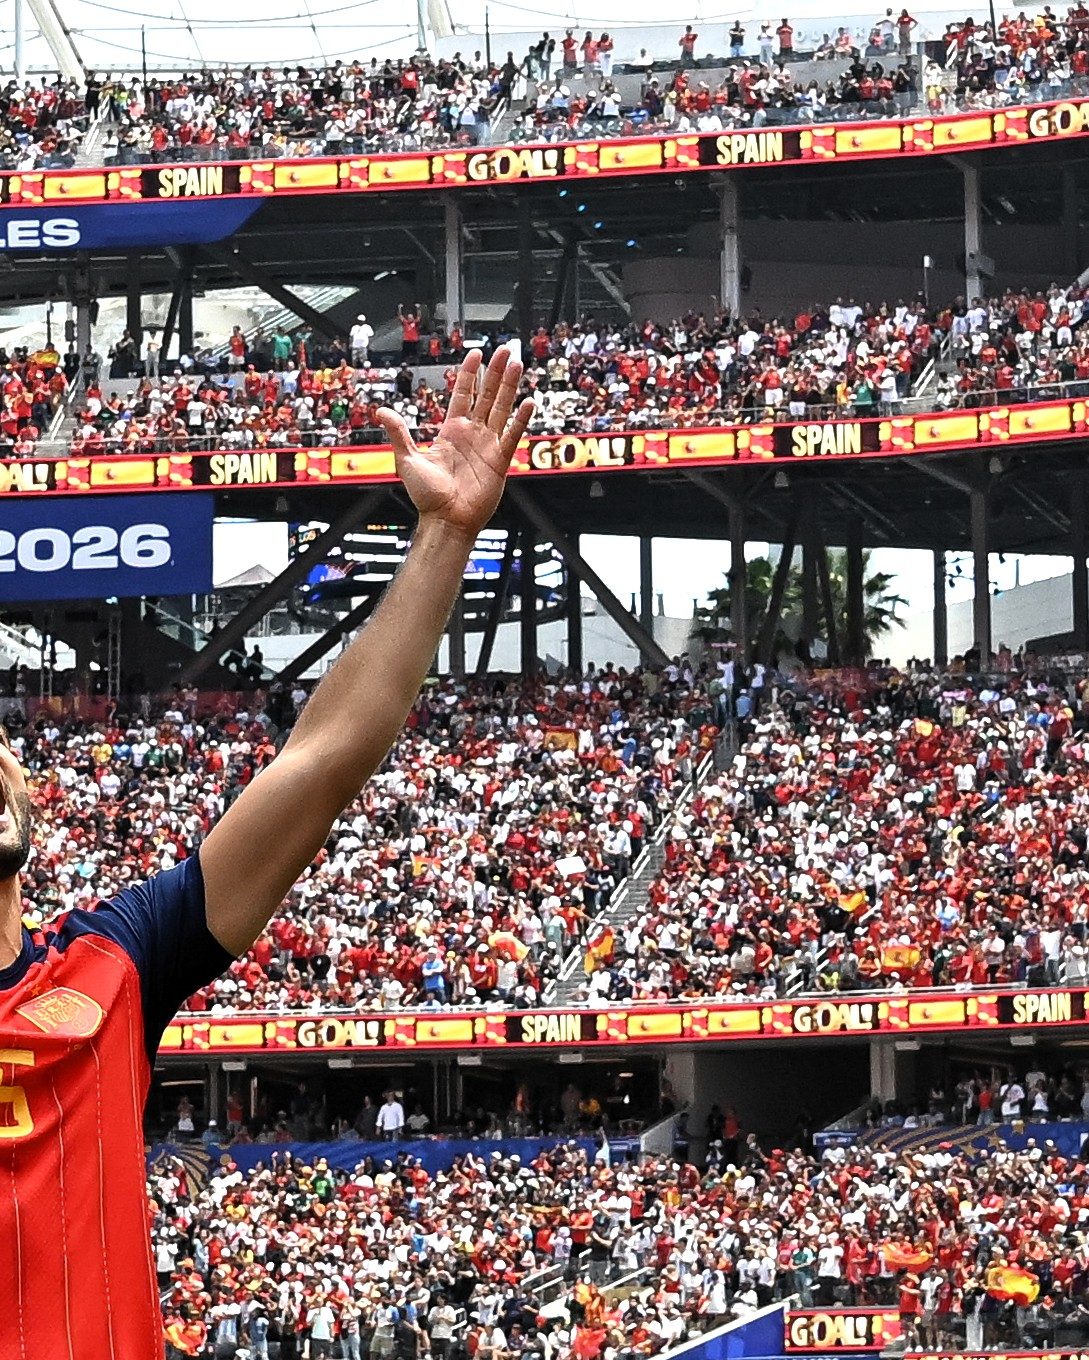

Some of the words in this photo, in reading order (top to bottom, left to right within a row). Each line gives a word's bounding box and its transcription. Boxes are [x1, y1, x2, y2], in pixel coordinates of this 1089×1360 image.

[158, 166, 223, 197] SPAIN
[468, 149, 558, 181] GOAL!
[716, 132, 783, 165] SPAIN
[210, 453, 277, 485] SPAIN
[531, 436, 626, 469] GOAL!
[792, 423, 861, 456] SPAIN
[298, 1018, 379, 1047] GOAL!
[522, 1014, 581, 1043] SPAIN
[793, 1001, 873, 1032] GOAL!
[1013, 993, 1071, 1023] SPAIN
[790, 1315, 867, 1347] GOAL!
